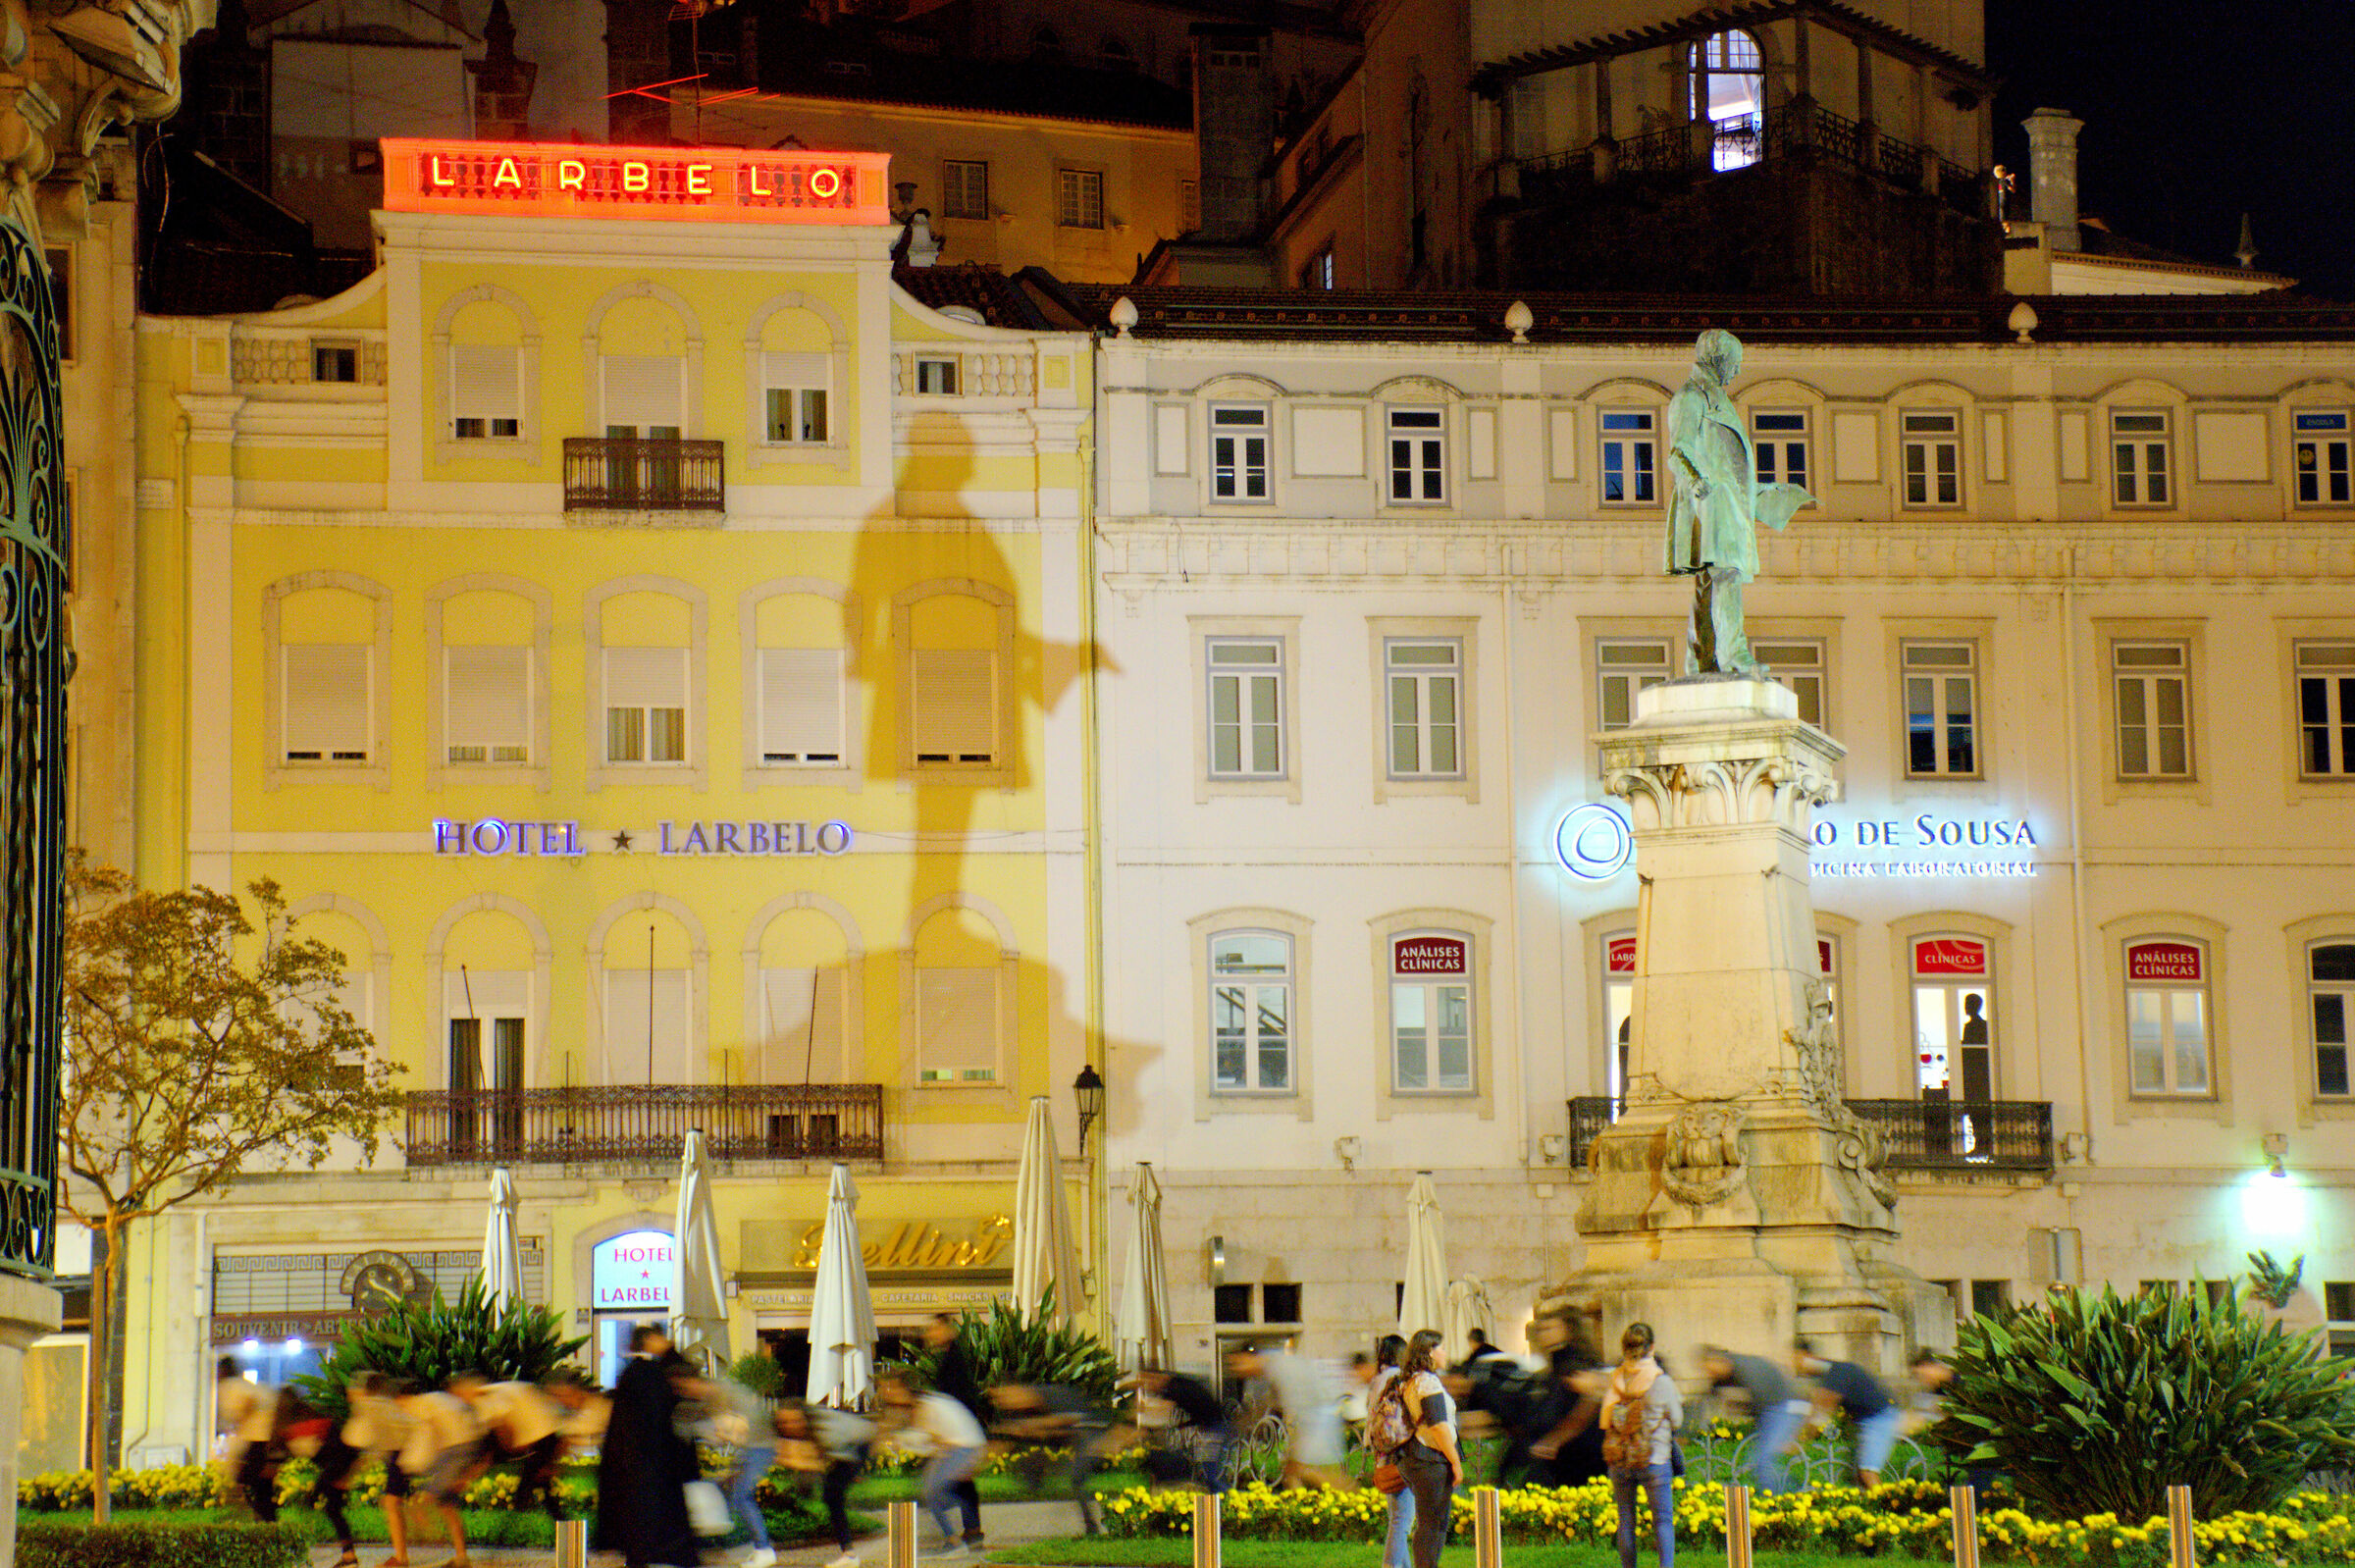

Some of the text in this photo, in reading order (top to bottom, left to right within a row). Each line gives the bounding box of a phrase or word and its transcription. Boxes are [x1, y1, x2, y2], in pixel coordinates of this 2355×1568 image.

[431, 156, 840, 198] LARBELO
[1855, 820, 1900, 848] DE
[1913, 813, 2038, 848] SOUSA
[433, 819, 853, 856] HOTEL LARBELO
[1400, 945, 1460, 958] ANÁLISES
[1611, 953, 1636, 962] LABO
[2134, 951, 2195, 964] ANÁLISES
[1400, 957, 1460, 969] CLÍNICAS
[1924, 953, 1976, 965] CLÍNICAS
[2134, 963, 2195, 975] CLÍNICAS
[614, 1247, 673, 1263] HOTEL
[602, 1286, 671, 1303] LARBEL
[881, 1292, 938, 1303] CAFETARIA
[948, 1292, 989, 1302] SNACKS
[213, 1320, 300, 1338] SOUVENIR
